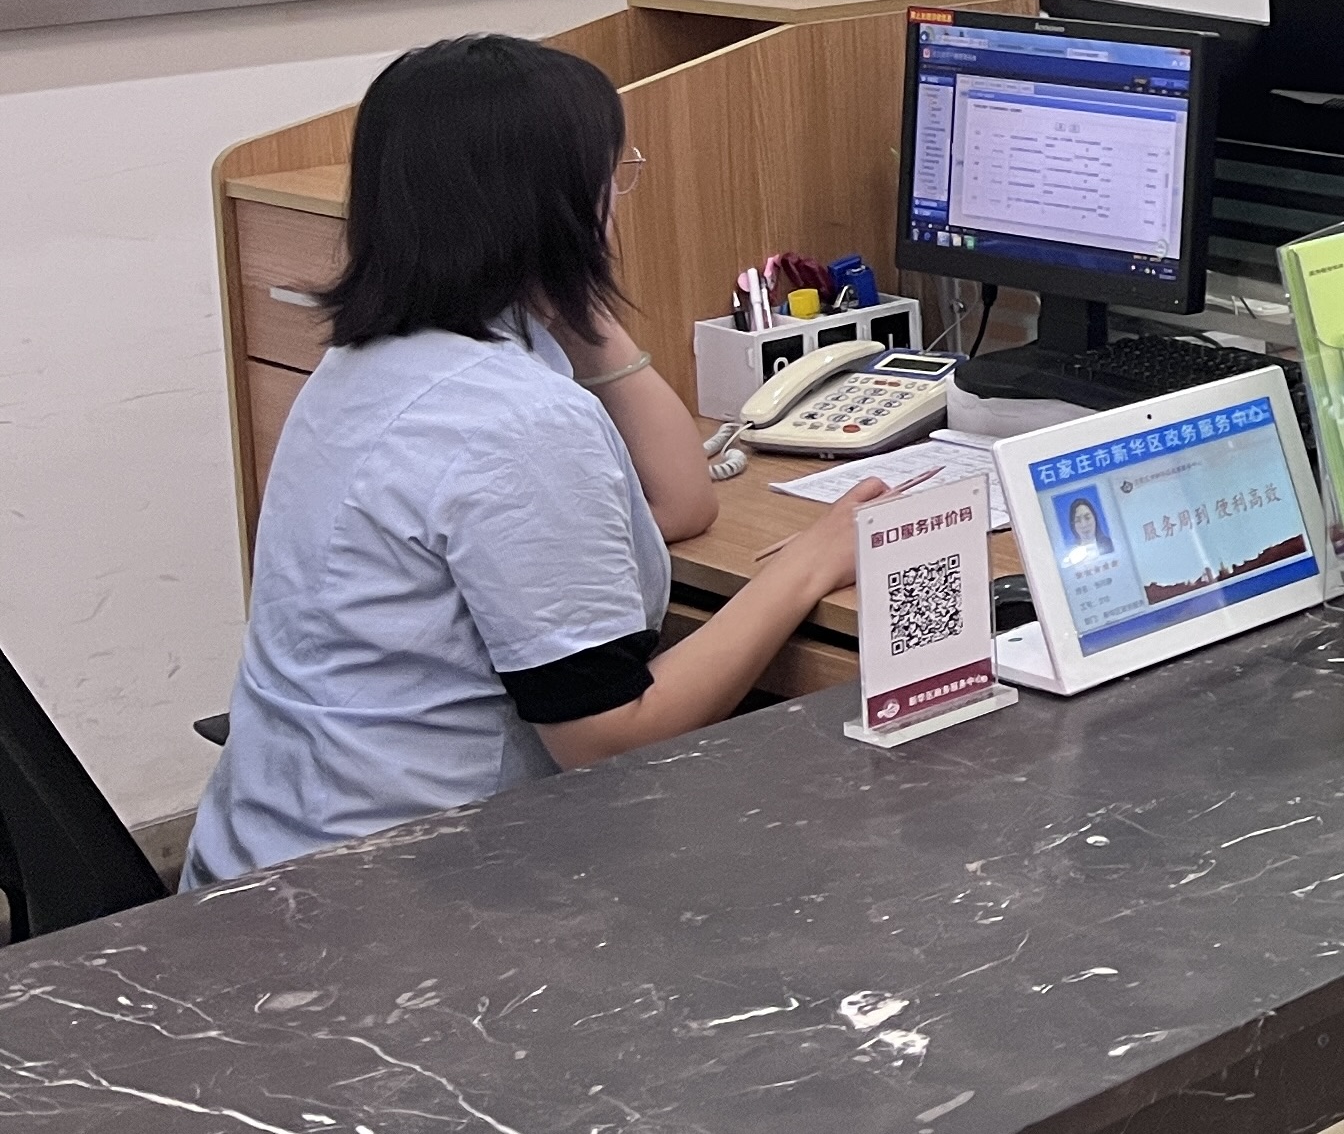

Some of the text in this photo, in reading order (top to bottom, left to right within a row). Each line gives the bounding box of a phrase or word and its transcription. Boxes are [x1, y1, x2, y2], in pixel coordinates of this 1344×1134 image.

[1037, 403, 1265, 485] 石家庄市新华区政务服务中心
[871, 506, 973, 549] 窗口服务评价码
